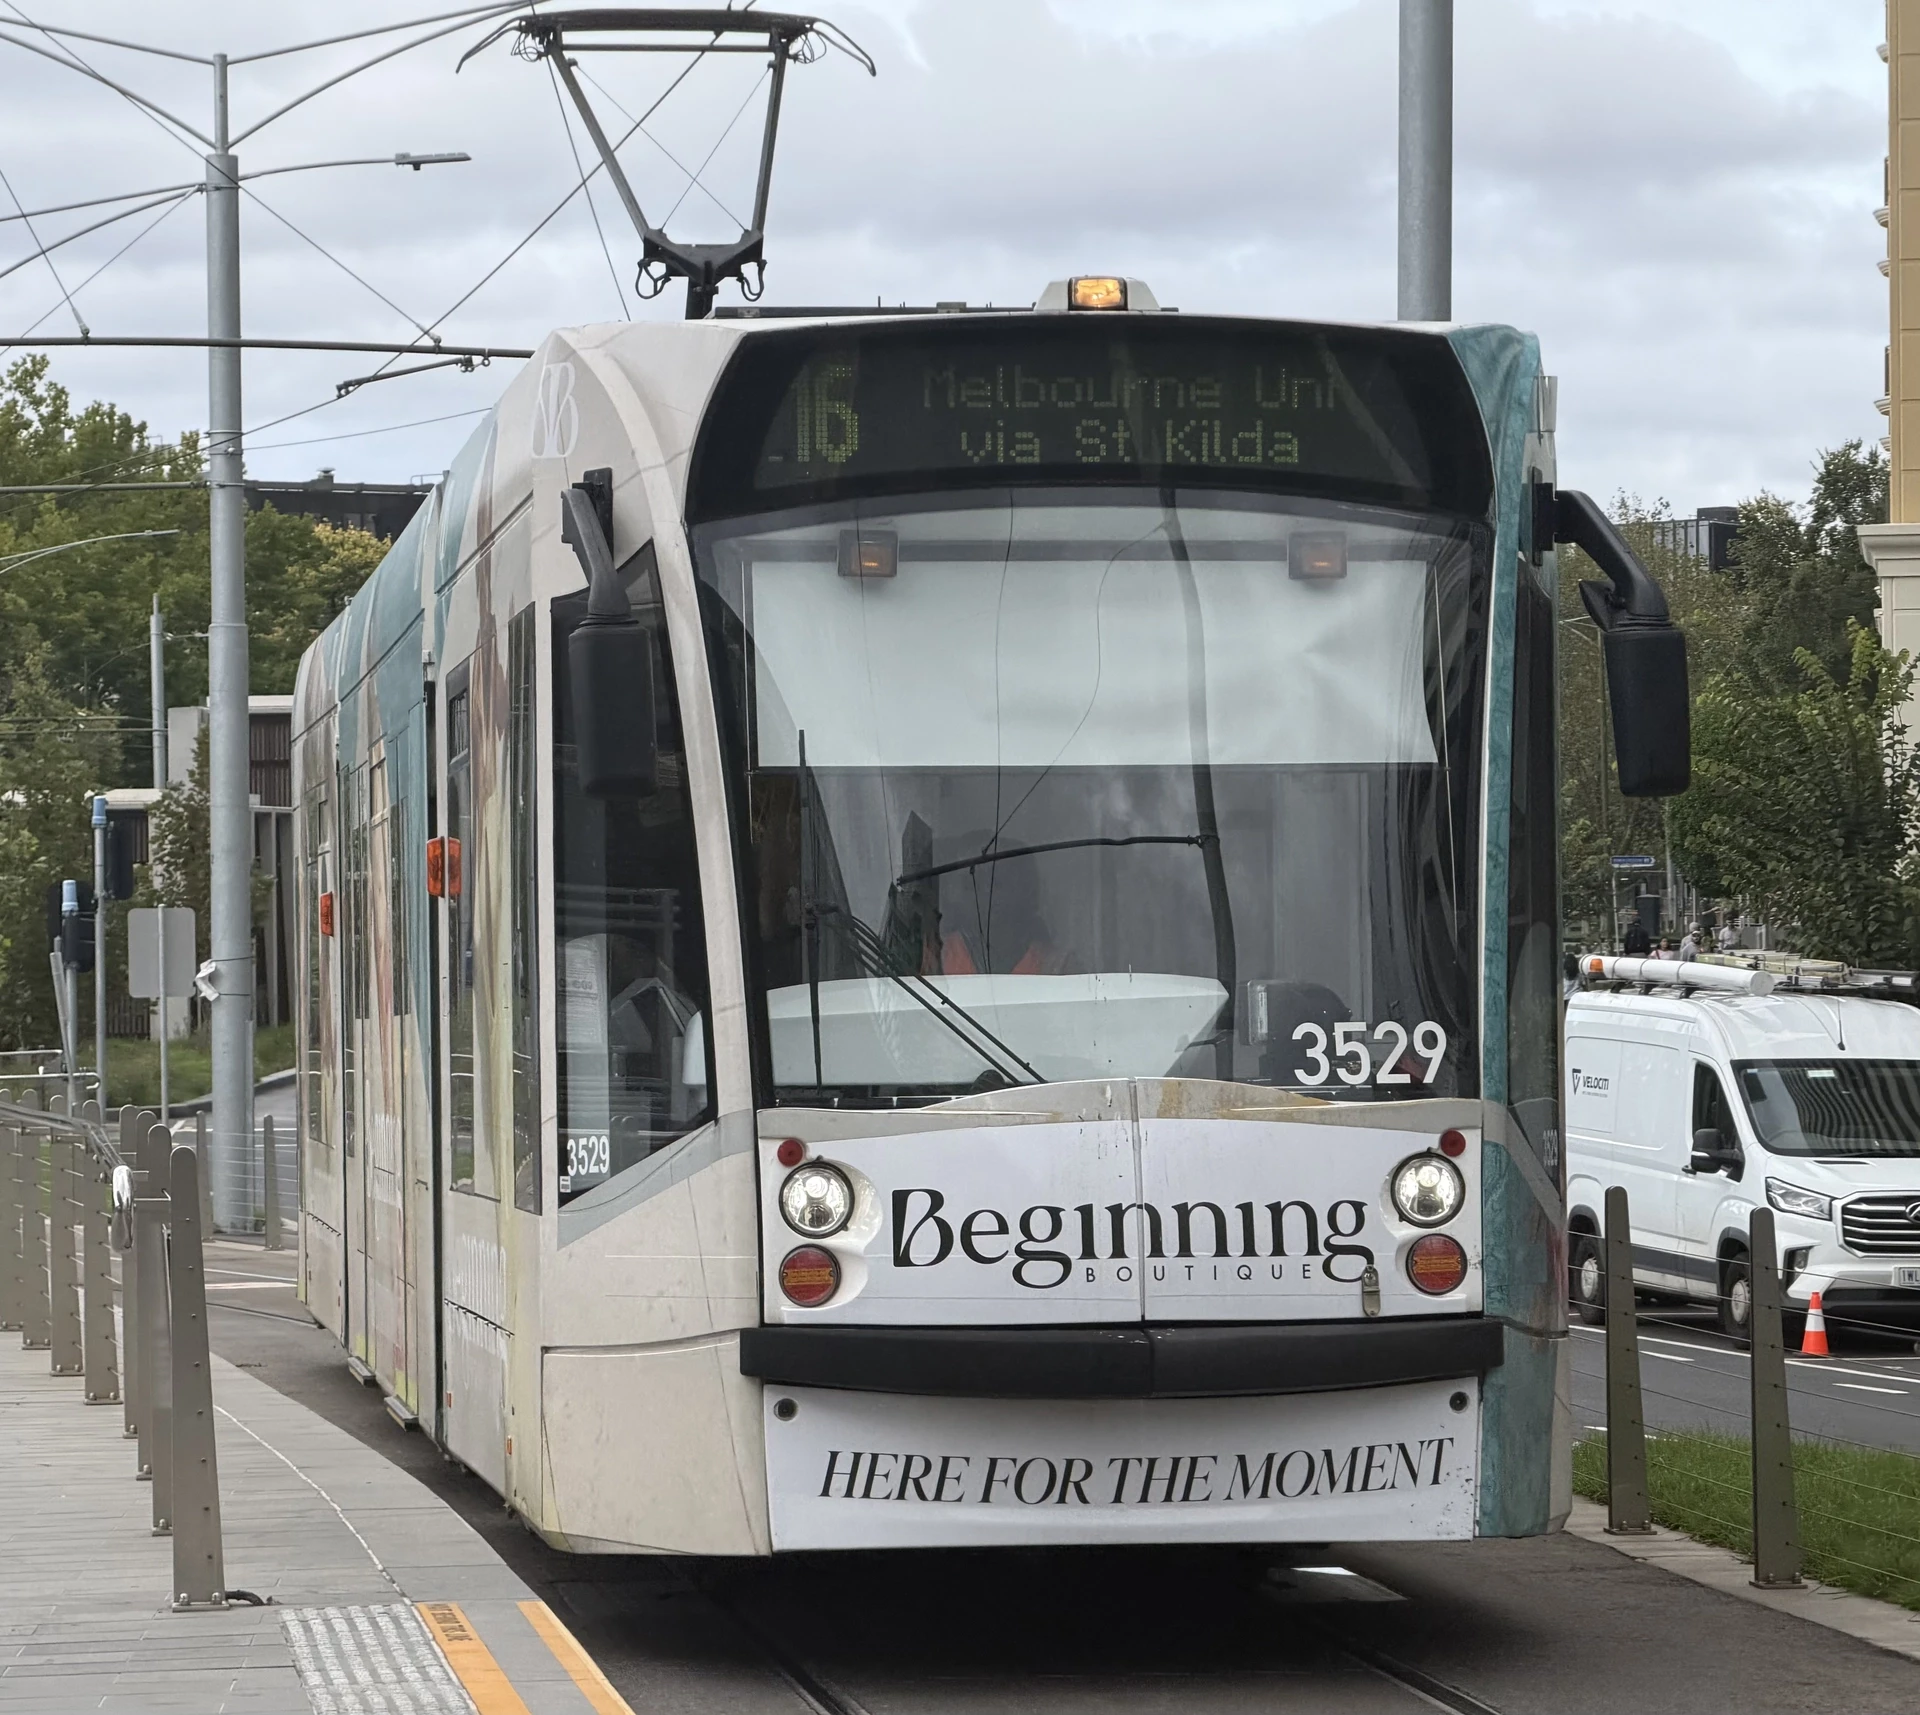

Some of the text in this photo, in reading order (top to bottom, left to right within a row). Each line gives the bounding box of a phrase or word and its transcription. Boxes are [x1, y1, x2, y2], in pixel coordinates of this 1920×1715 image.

[924, 364, 1221, 408] Melbourne
[961, 419, 1299, 463] via St Kilda
[1291, 1020, 1447, 1086] 3529
[566, 1134, 611, 1177] 3529
[891, 1188, 1378, 1289] Beginning
[1085, 1265, 1312, 1284] BOUTIQUE
[817, 1436, 1455, 1505] HERE FOR THE MOMENT
